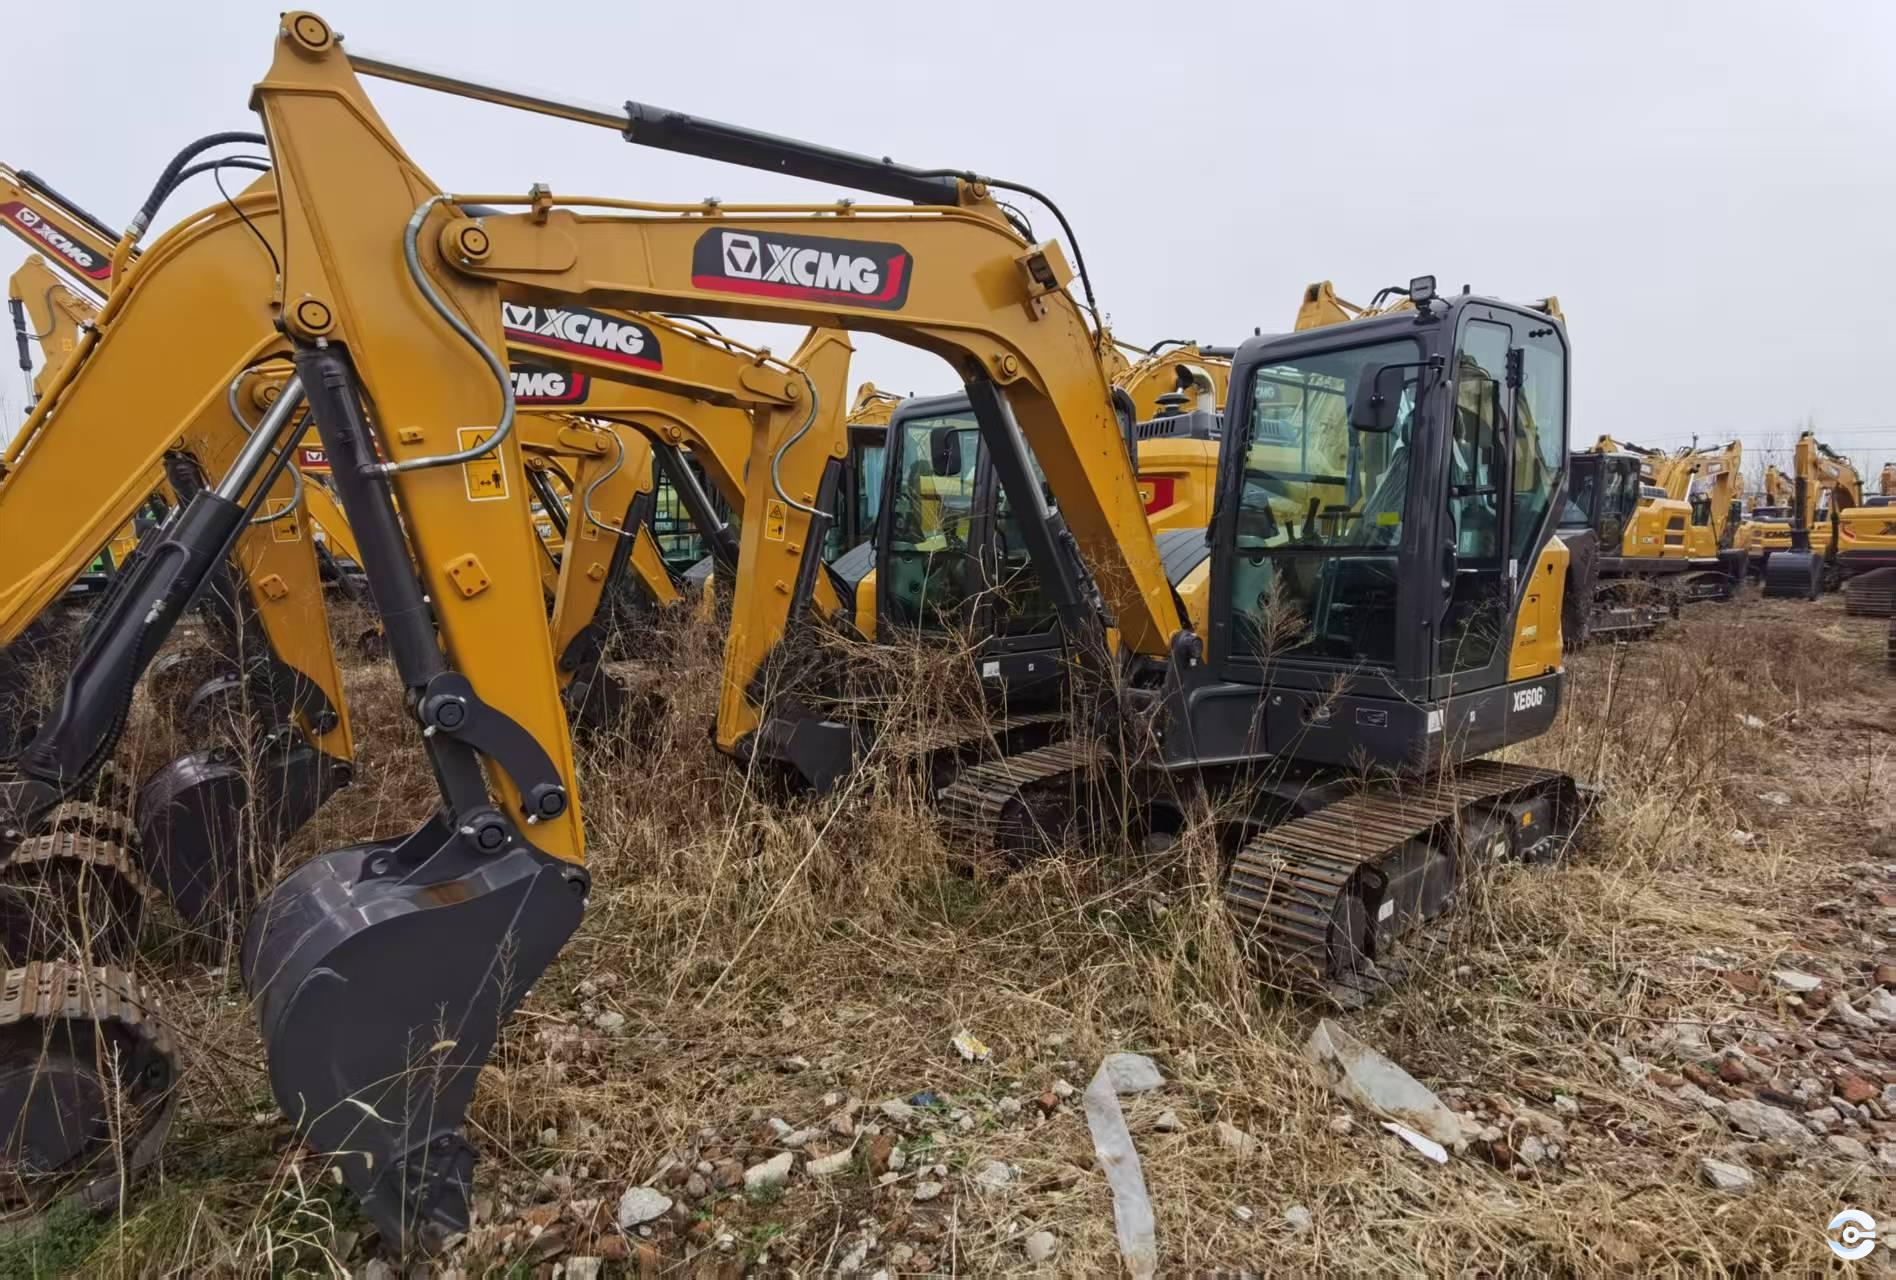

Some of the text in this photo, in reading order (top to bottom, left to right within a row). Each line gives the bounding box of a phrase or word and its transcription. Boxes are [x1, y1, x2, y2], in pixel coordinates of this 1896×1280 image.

[32, 223, 93, 267] XCMG
[762, 243, 879, 294] XCMG
[535, 308, 644, 354] XCMG
[510, 373, 566, 397] MG
